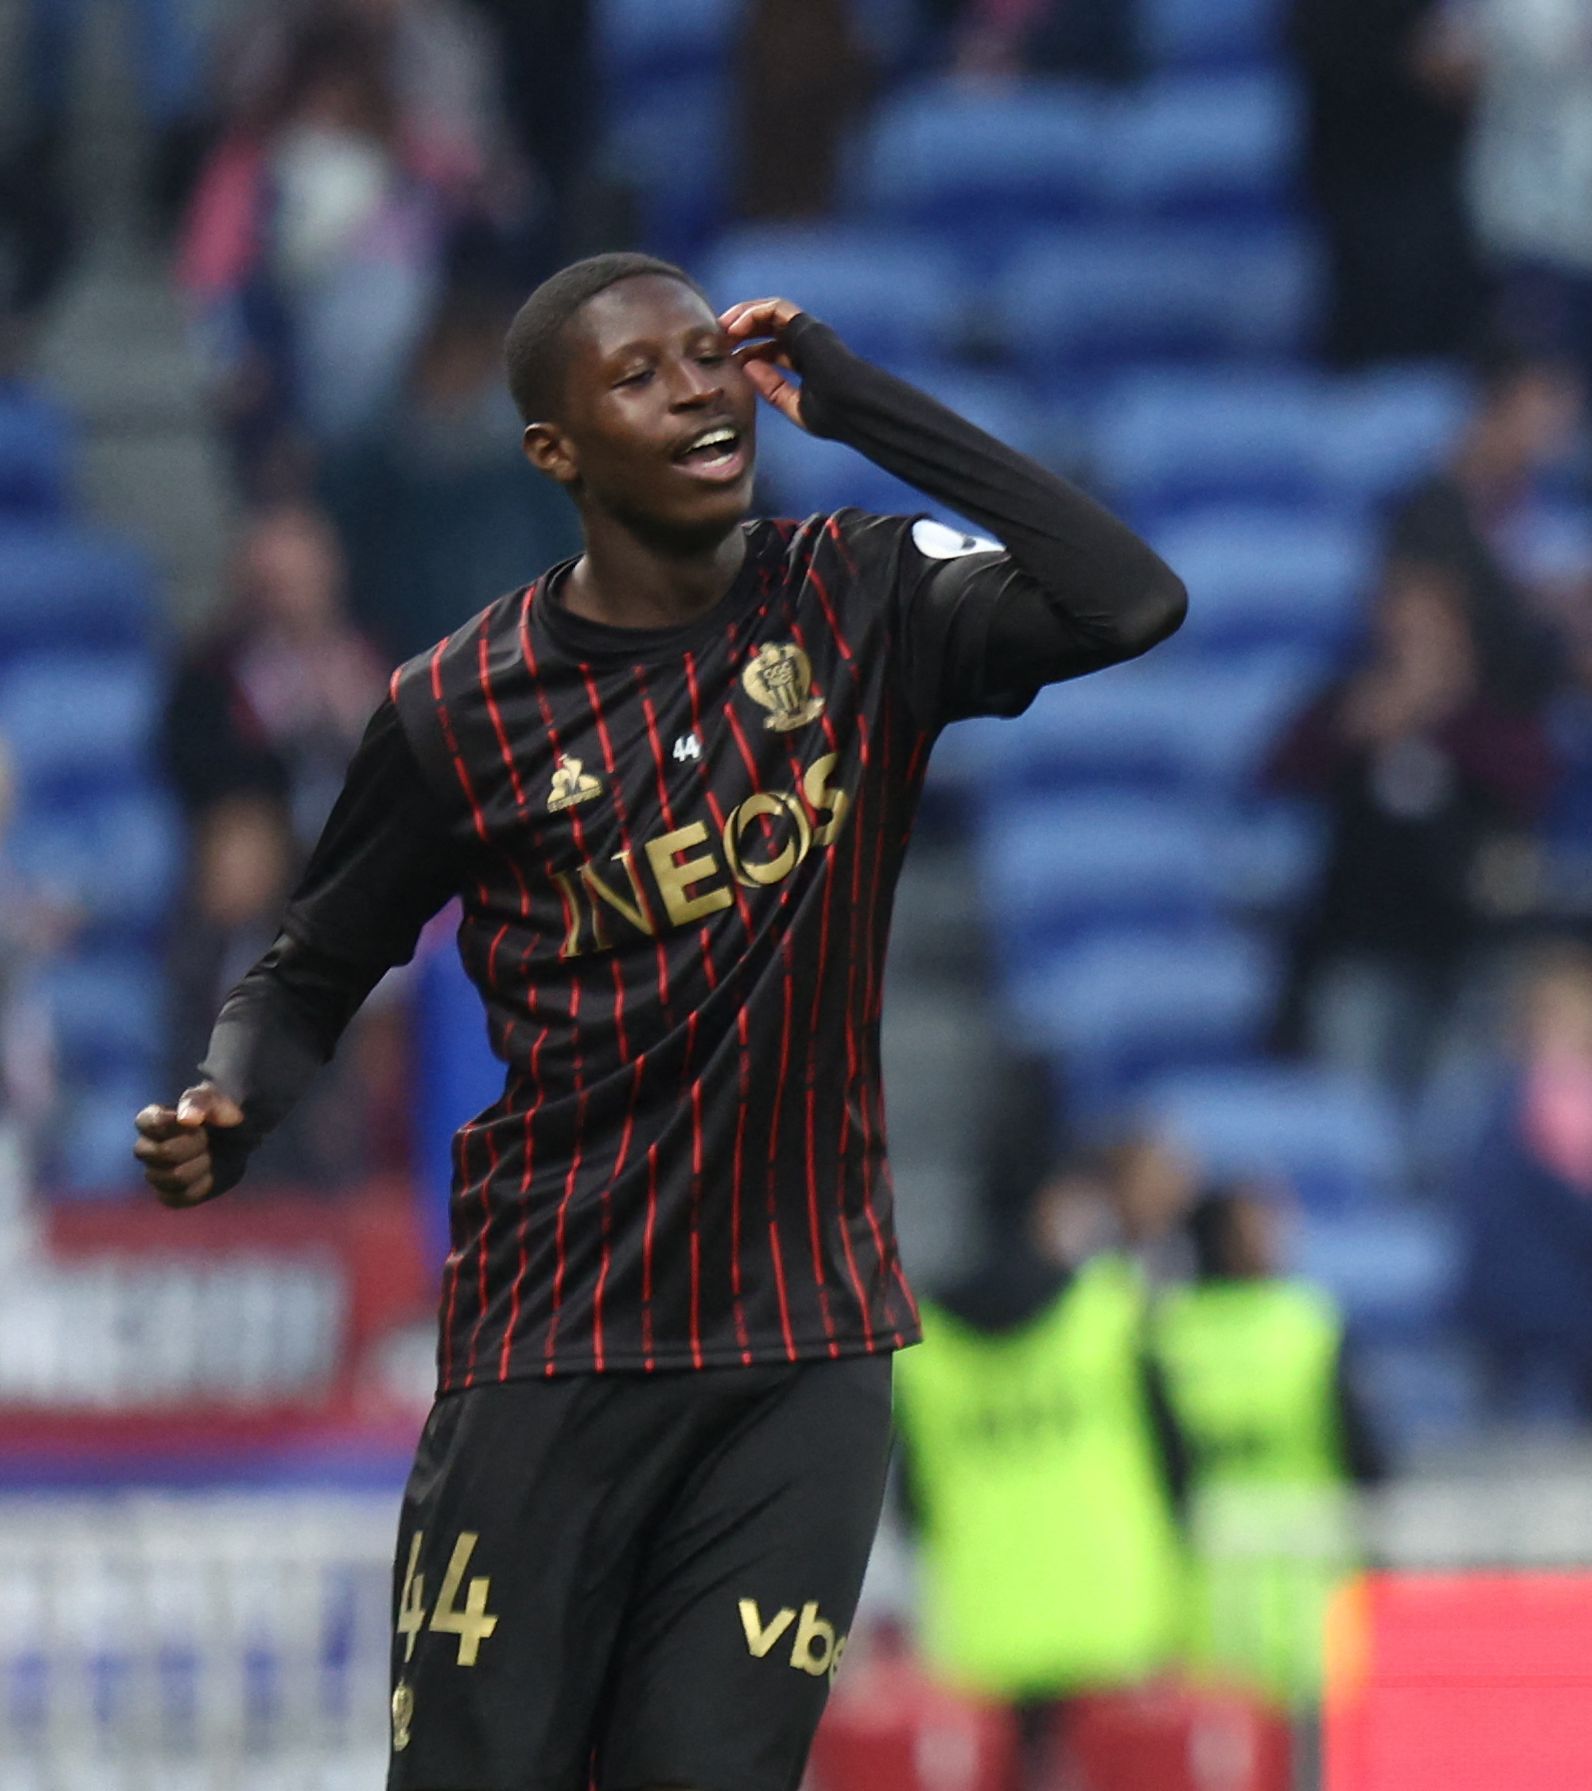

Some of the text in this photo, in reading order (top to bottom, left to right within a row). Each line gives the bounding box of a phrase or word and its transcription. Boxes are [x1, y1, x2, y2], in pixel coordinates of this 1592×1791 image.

[673, 733, 700, 762] 44
[550, 752, 849, 958] INEOS
[397, 1531, 498, 1667] 44
